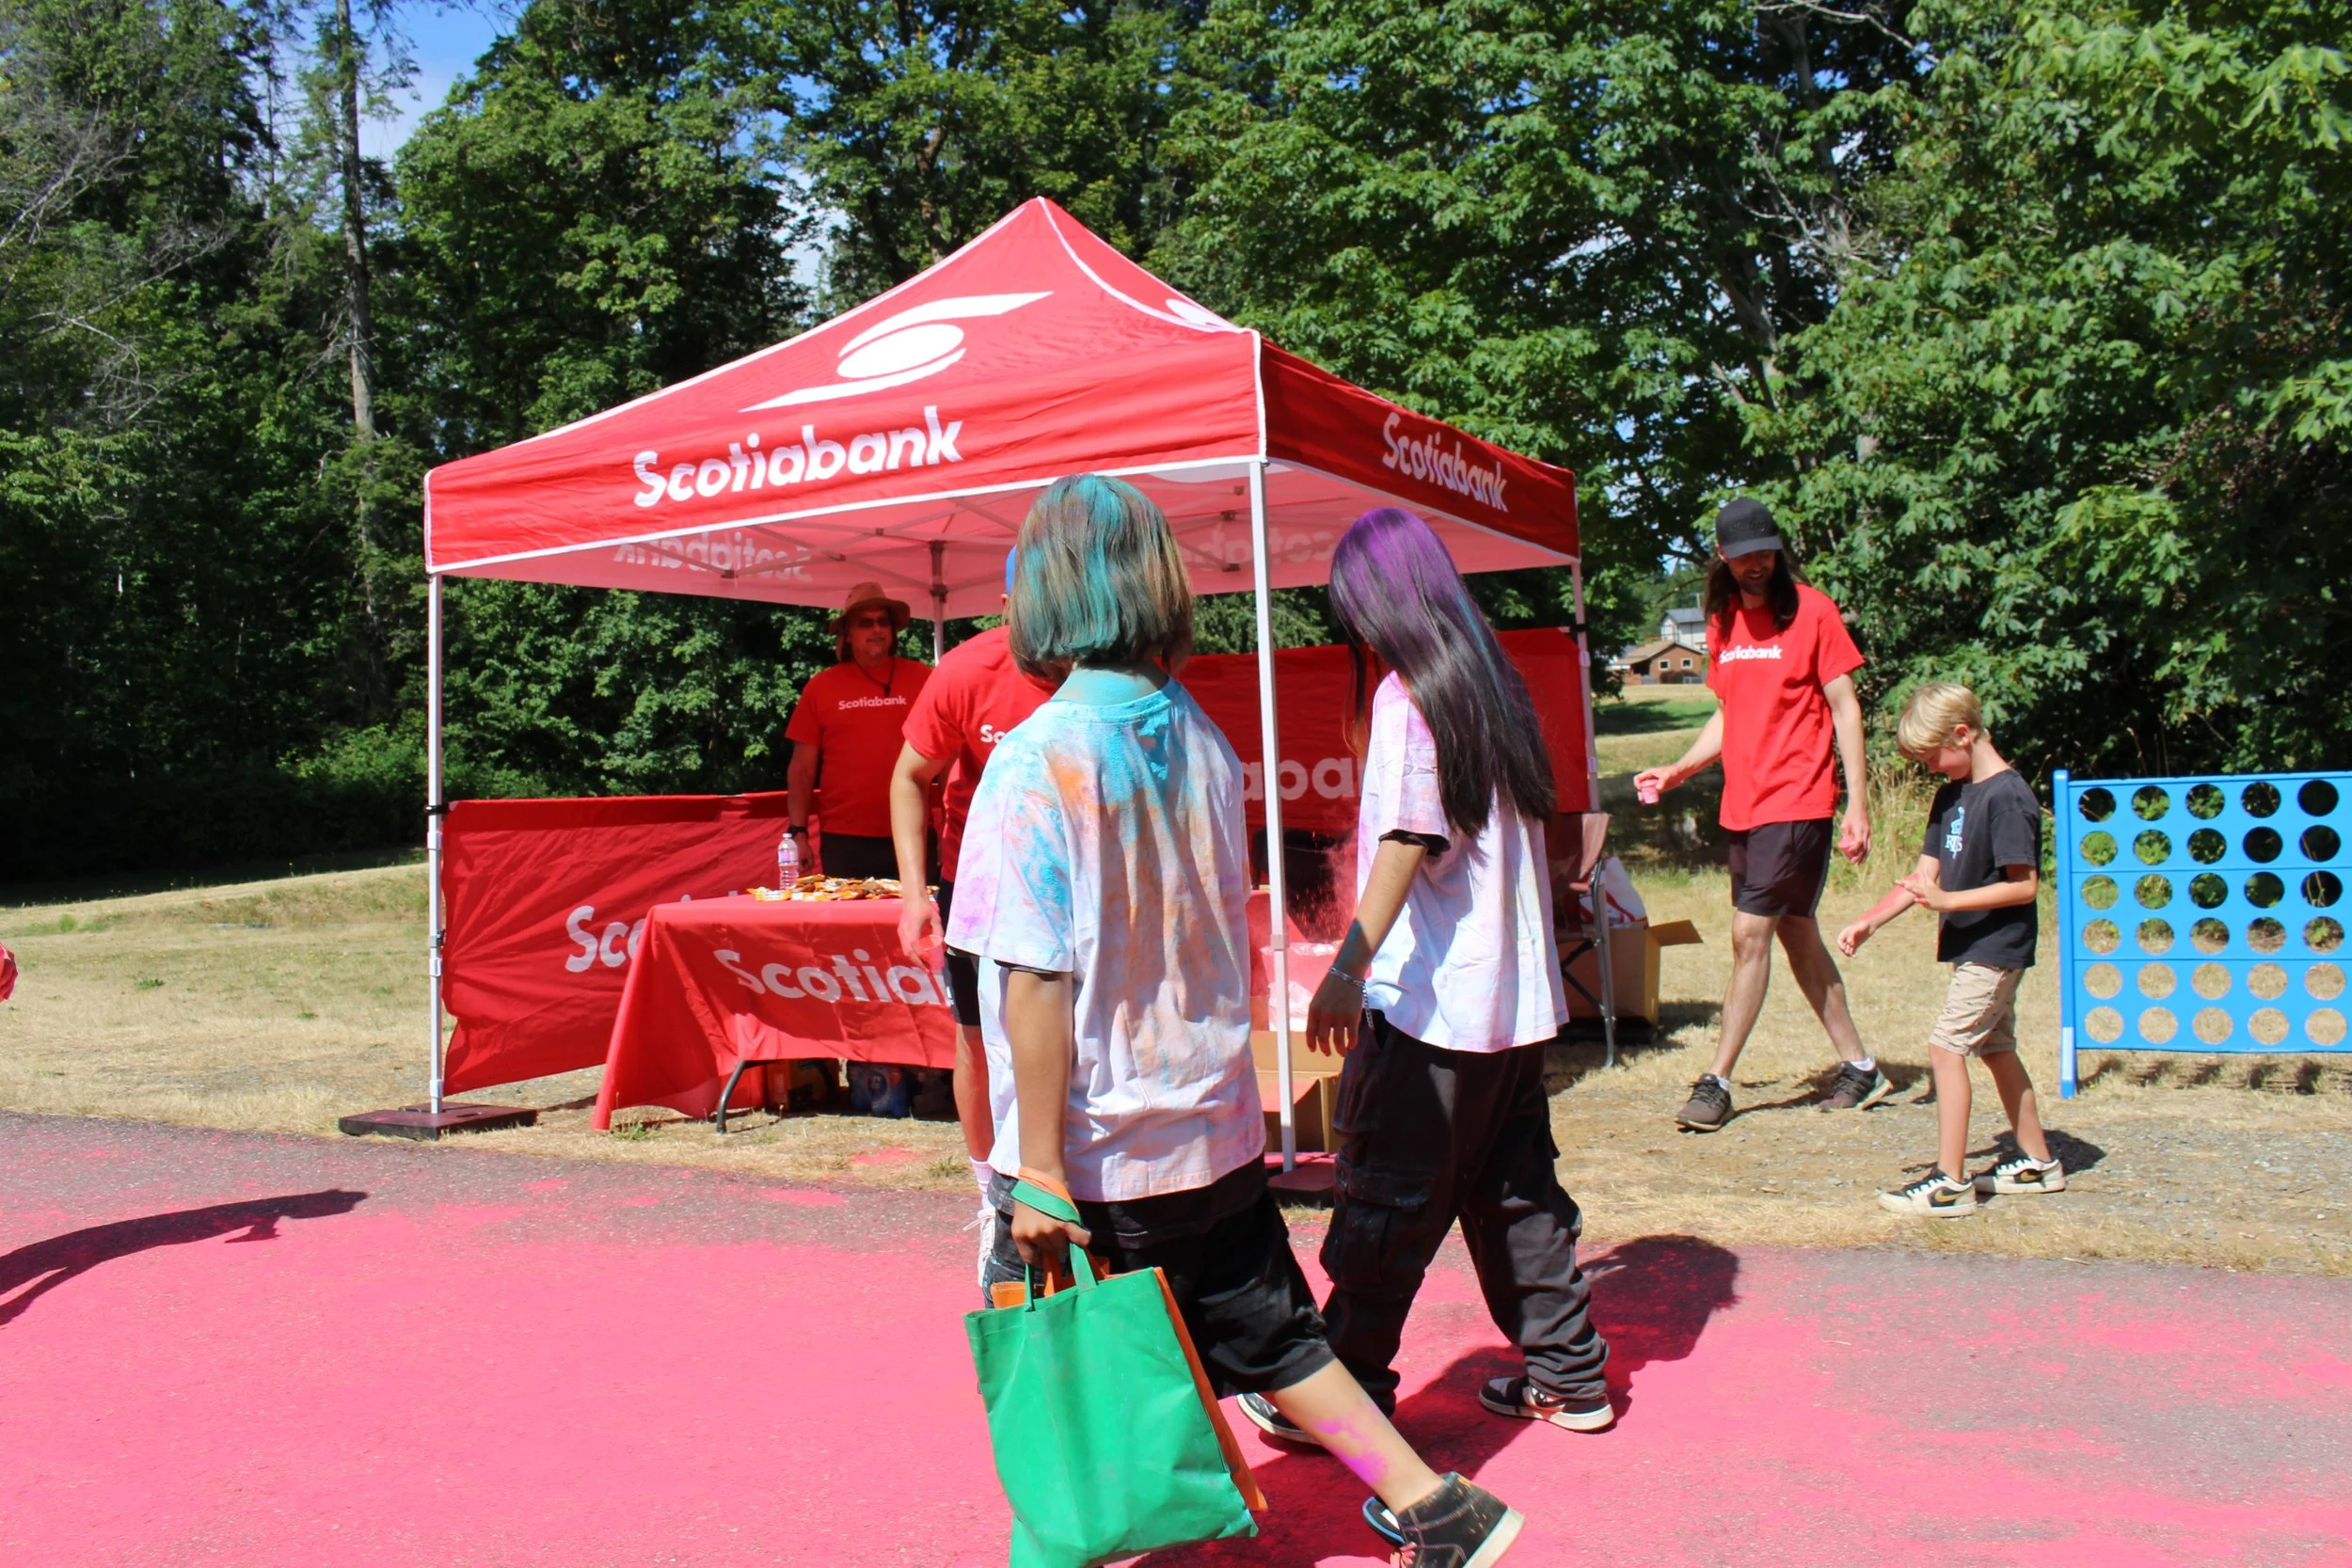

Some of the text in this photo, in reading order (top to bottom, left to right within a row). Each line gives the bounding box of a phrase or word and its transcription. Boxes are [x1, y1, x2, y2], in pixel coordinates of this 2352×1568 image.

[633, 405, 964, 508] Scotiabank
[1382, 412, 1509, 513] Scotiabank
[838, 696, 907, 710] Scotiabank
